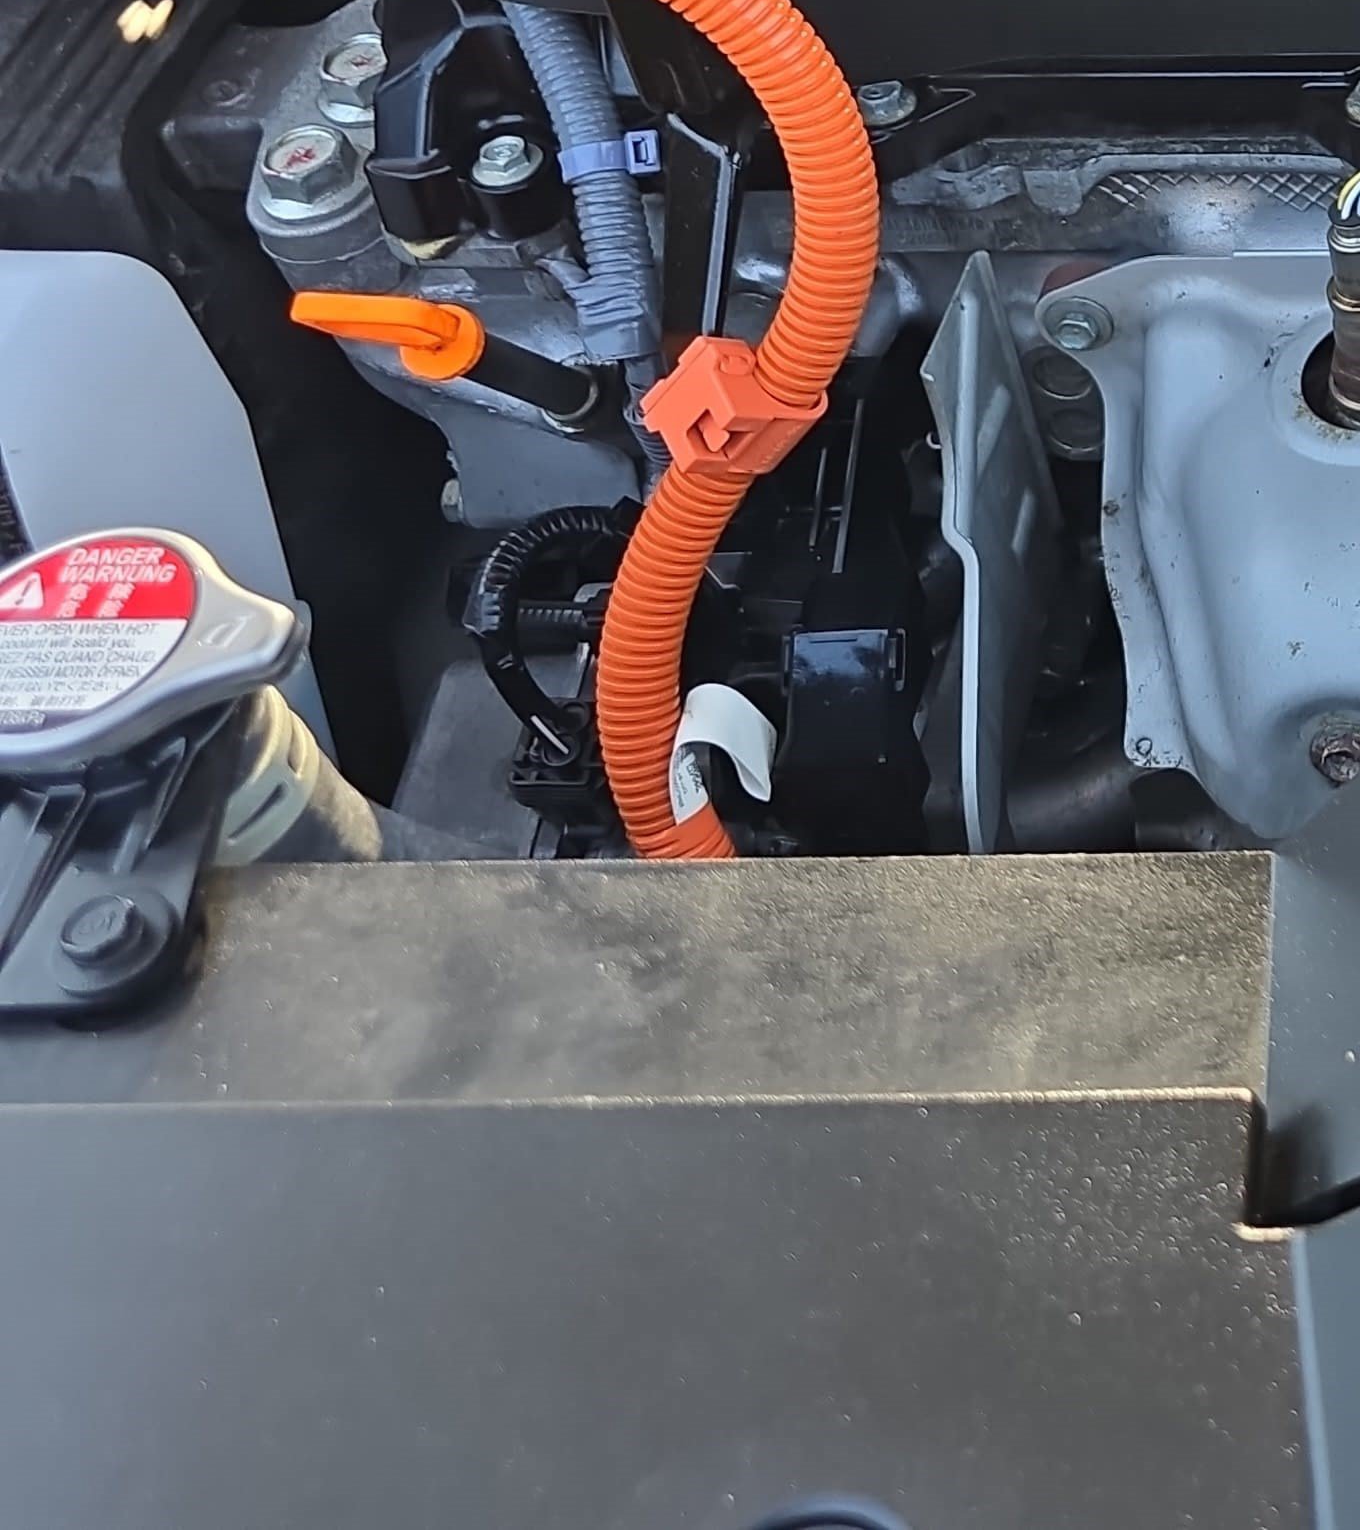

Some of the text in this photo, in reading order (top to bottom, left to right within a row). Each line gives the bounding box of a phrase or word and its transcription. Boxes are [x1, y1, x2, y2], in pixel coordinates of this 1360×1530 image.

[67, 547, 166, 566] DANGER
[58, 564, 177, 582] WARNUNG
[34, 623, 74, 636] OPEN
[79, 623, 122, 636] WHEN
